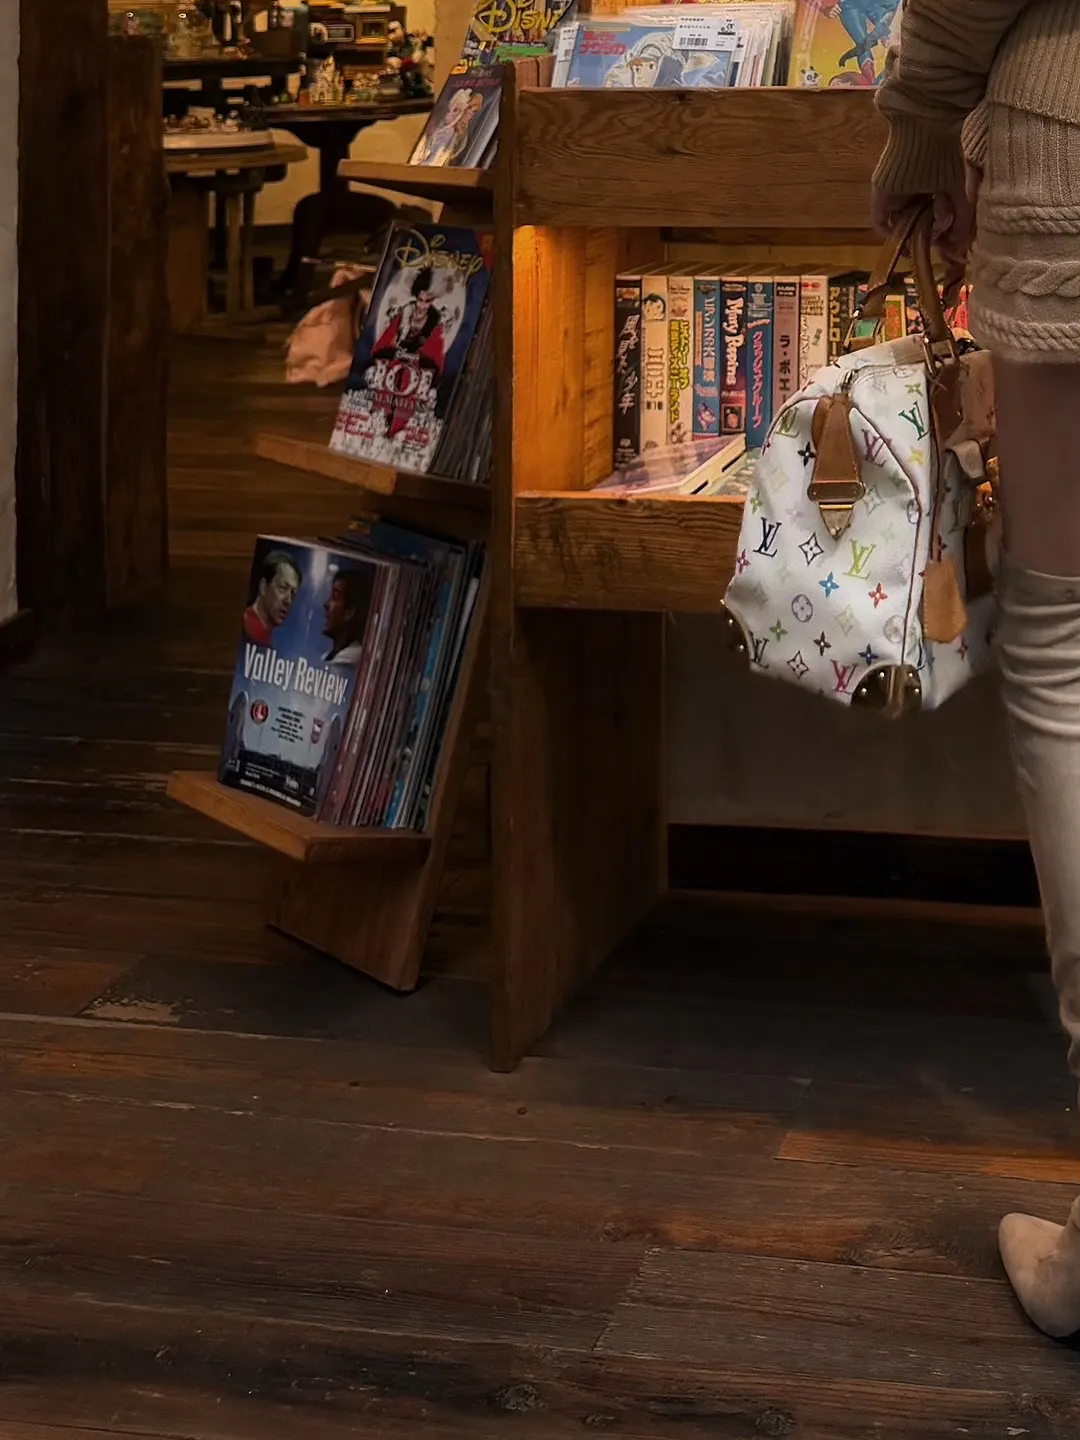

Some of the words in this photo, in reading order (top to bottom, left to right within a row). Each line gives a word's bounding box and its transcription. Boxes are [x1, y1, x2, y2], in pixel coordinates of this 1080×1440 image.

[722, 296, 744, 334] Mary
[725, 334, 745, 386] Poppins
[244, 642, 299, 691] Valley
[295, 656, 349, 706] Review
